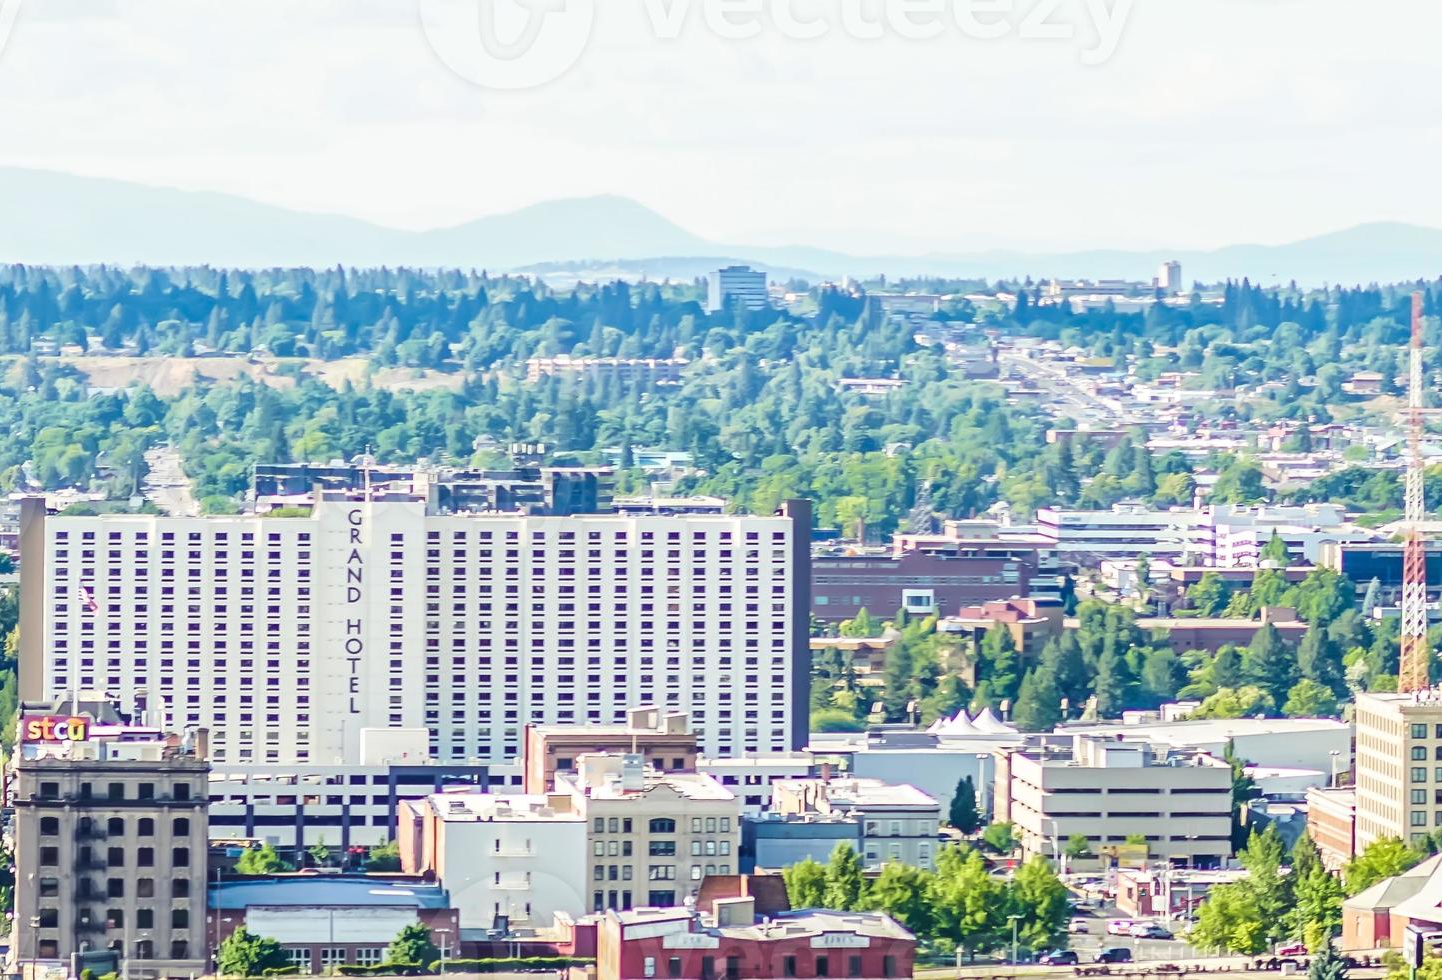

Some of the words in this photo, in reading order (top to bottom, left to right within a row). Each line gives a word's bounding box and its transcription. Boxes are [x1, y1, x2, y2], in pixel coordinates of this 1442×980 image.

[347, 509, 363, 603] GRAND
[345, 619, 363, 713] HOTEL
[27, 717, 85, 741] stcu
